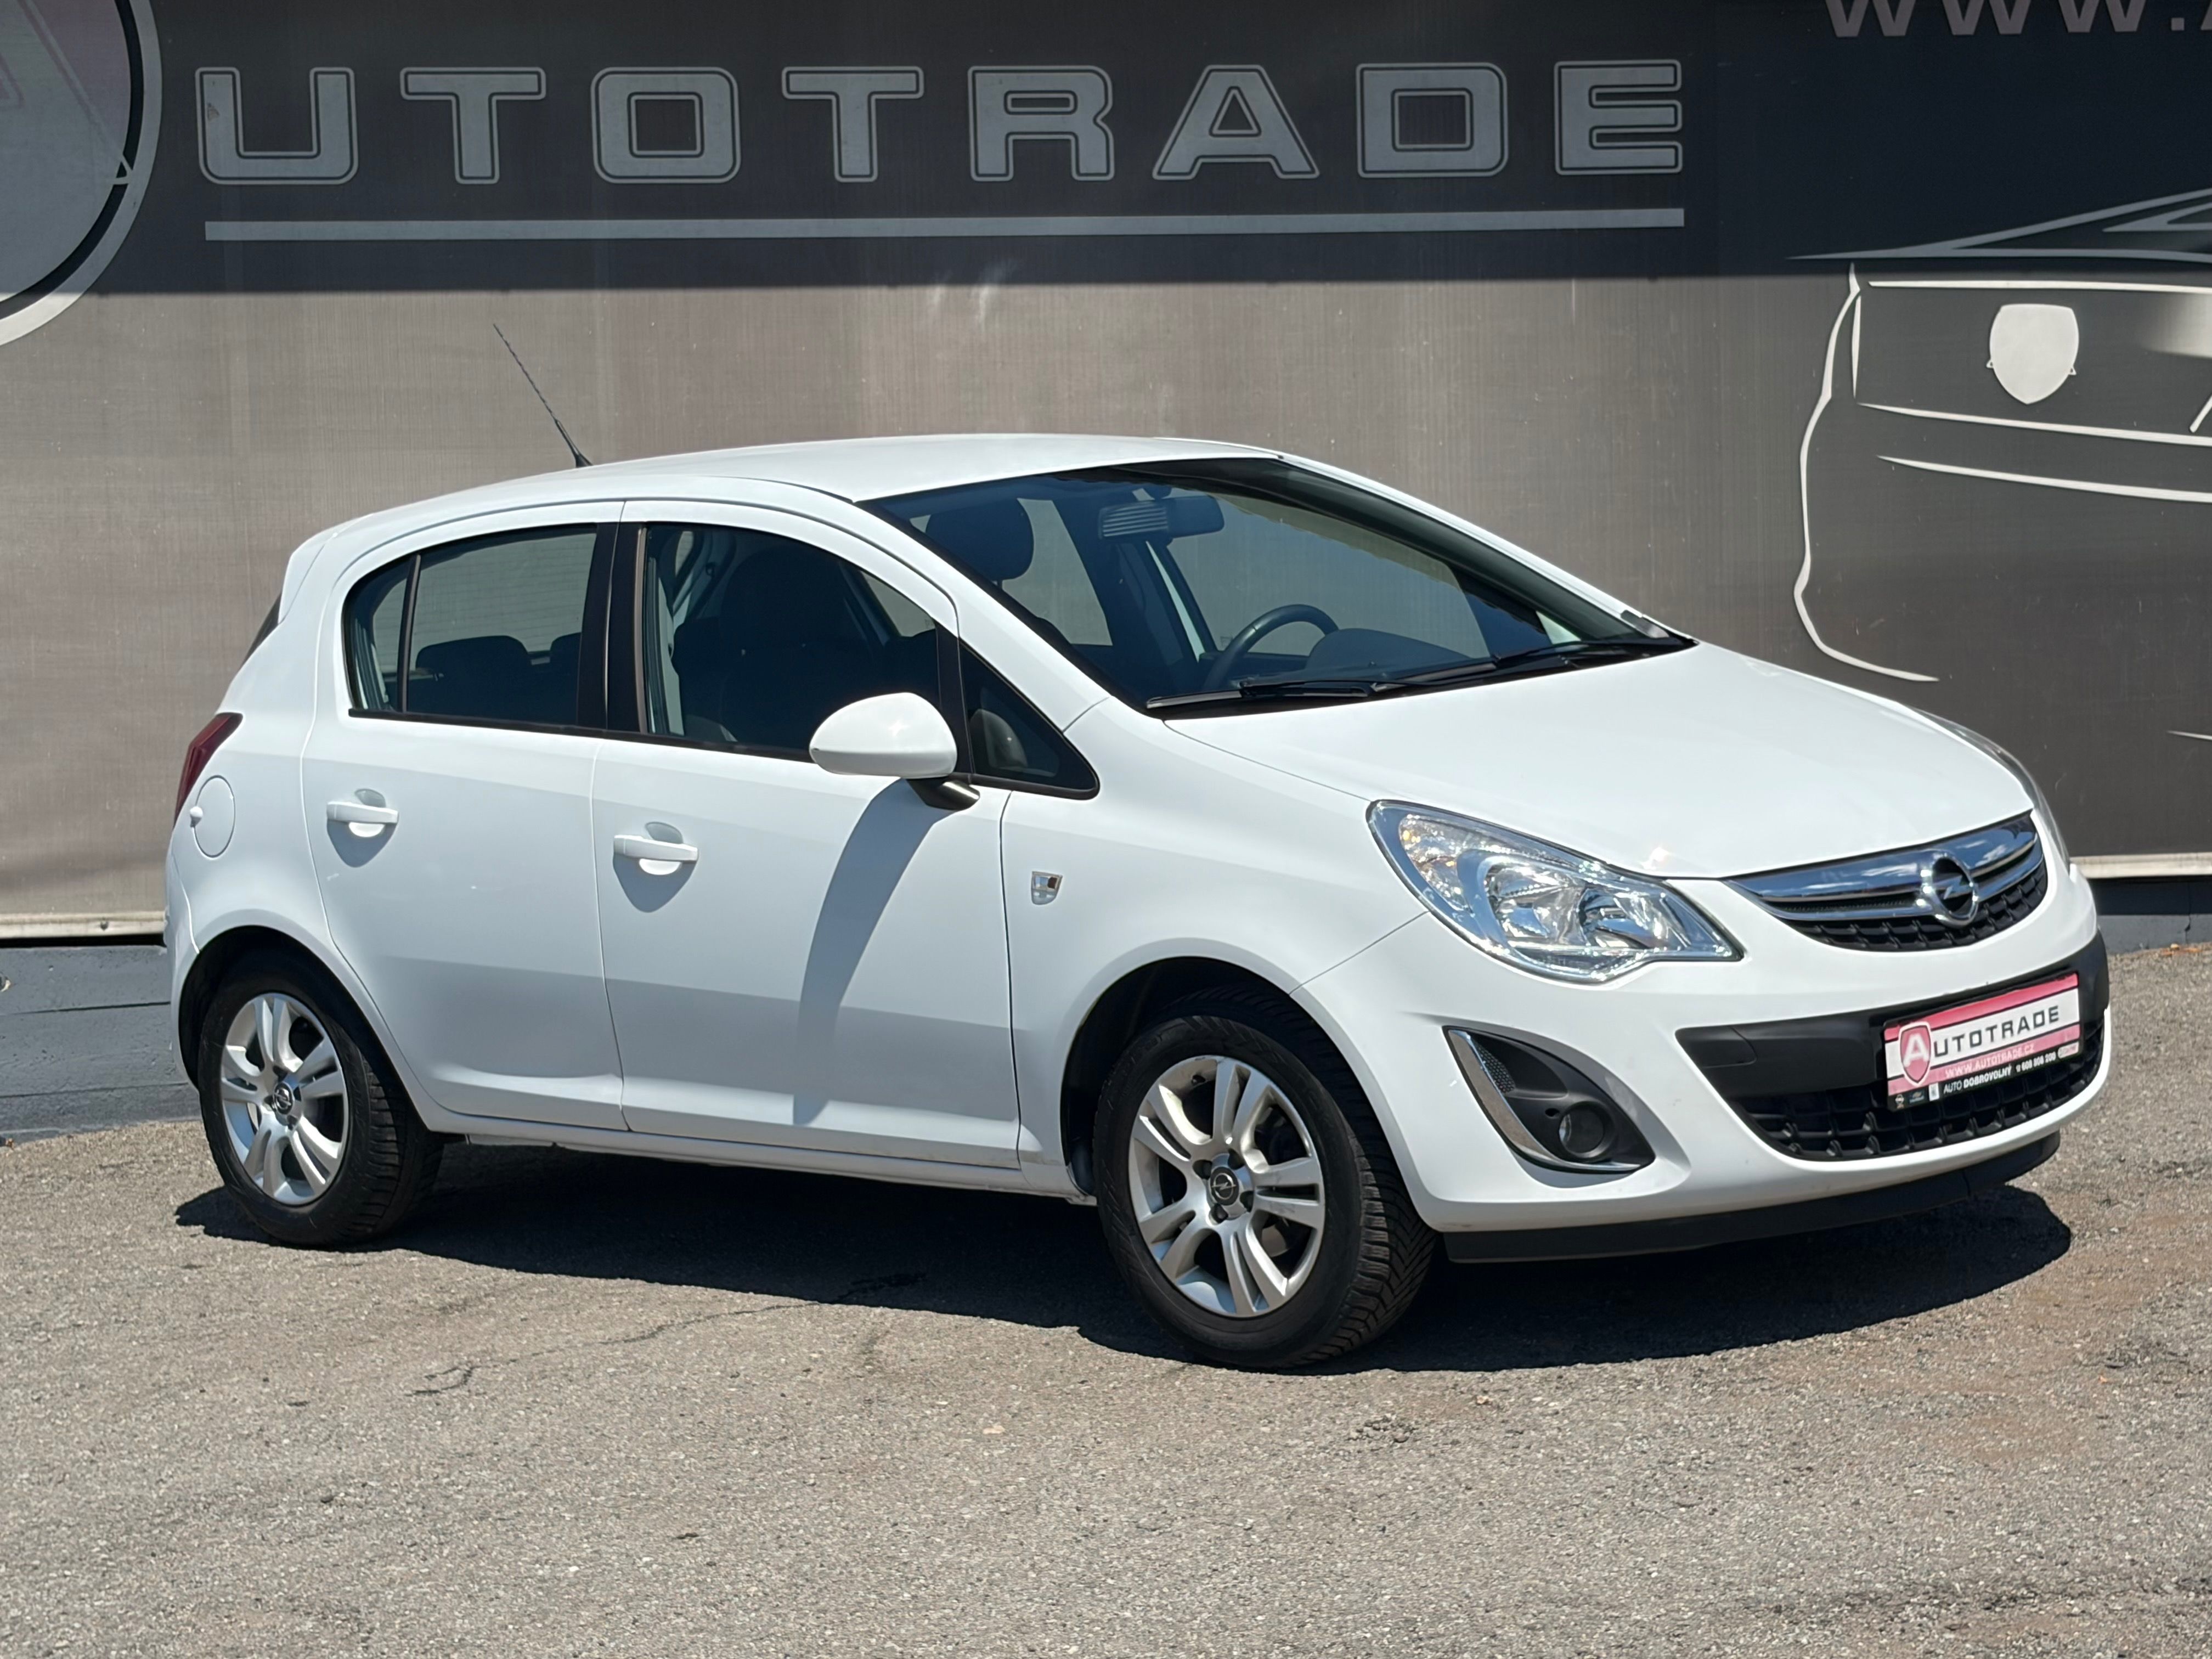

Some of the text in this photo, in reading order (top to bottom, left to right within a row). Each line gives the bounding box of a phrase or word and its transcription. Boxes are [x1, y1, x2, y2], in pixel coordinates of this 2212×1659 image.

[1825, 0, 2212, 37] WWW.
[1903, 1005, 2059, 1068] AUTOTRADE
[1944, 1080, 1962, 1094] AUTO
[1963, 1063, 2012, 1088] DOBROVOLNÝ
[1945, 1043, 2035, 1079] WWW.AUTOTRADE.CZ
